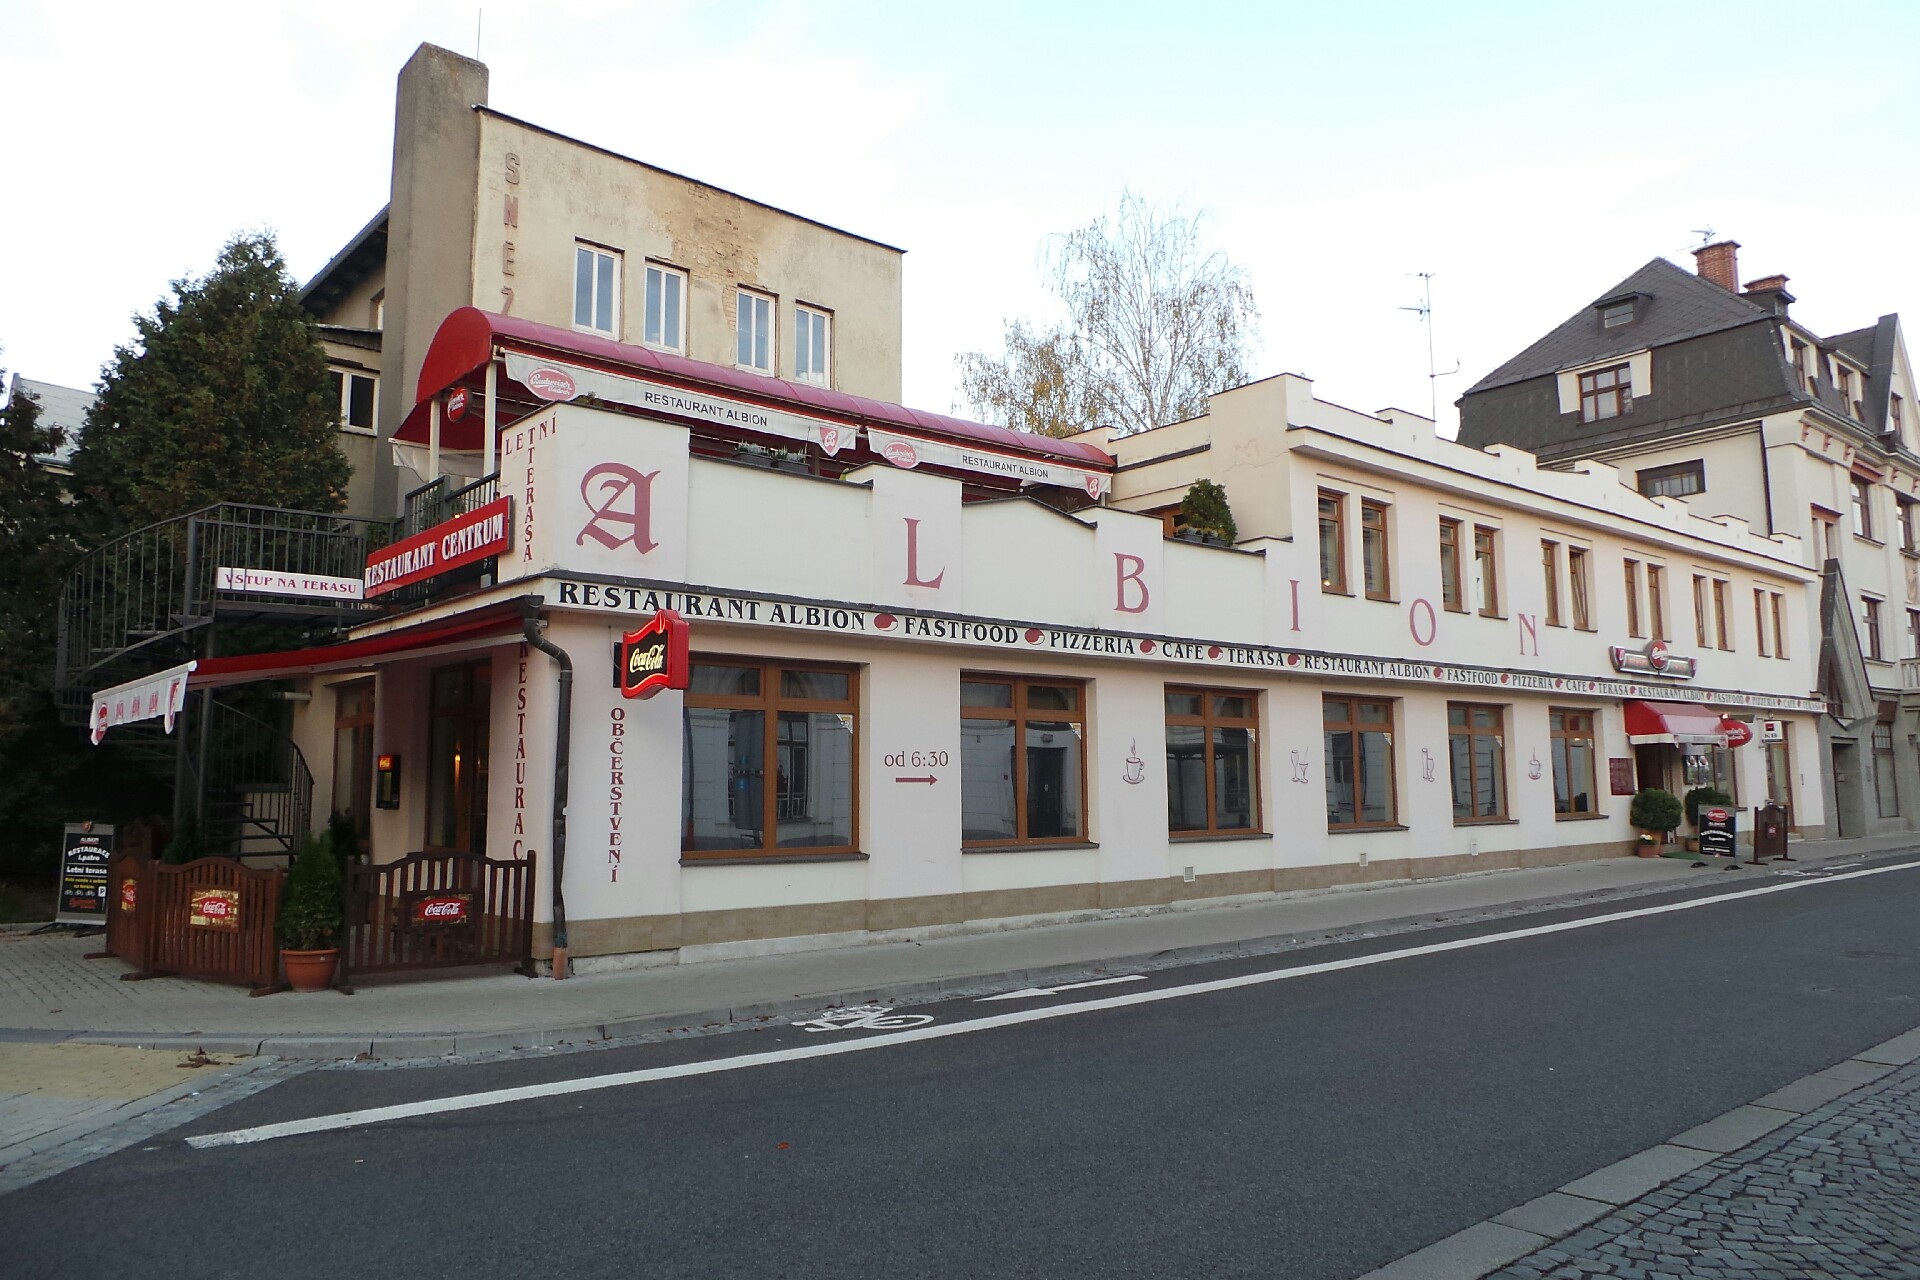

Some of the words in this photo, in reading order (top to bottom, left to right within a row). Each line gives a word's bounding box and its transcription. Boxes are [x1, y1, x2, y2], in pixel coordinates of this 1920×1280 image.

[645, 391, 723, 418] RESTAURANT
[726, 409, 767, 427] ALBION
[505, 411, 557, 456] LETNÍ
[962, 455, 1018, 474] RESTAURANT
[1019, 465, 1049, 479] ALBION
[523, 446, 535, 563] TERASA
[365, 541, 436, 589] RESTAURANT
[441, 512, 504, 561] CENTRUM
[225, 574, 273, 586] VSTUP
[278, 578, 297, 589] NA
[303, 580, 357, 594] TERASU
[559, 582, 761, 621] RESTAURANT
[769, 603, 866, 631] ALBION
[904, 616, 1019, 644] FASTFOOD
[1050, 632, 1135, 655] PIZZERIA
[1162, 641, 1204, 660] CAFE
[1228, 648, 1285, 667] TERASA
[1304, 655, 1385, 676] RESTAURANT
[1389, 663, 1430, 679] ALBION
[1447, 668, 1498, 685] FASTFOOD
[1512, 674, 1553, 690] PIZZERIA
[1566, 679, 1587, 692] CAFE
[1599, 682, 1629, 696] TERASA
[1638, 686, 1682, 699] RESTAURANT
[1683, 689, 1705, 700] ALBION
[630, 643, 666, 673] Coca-Cola
[884, 750, 905, 768] od
[911, 750, 949, 768] 6:30
[608, 707, 626, 883] OBČERSTVENÍ
[424, 902, 461, 917] Coca-Cola
